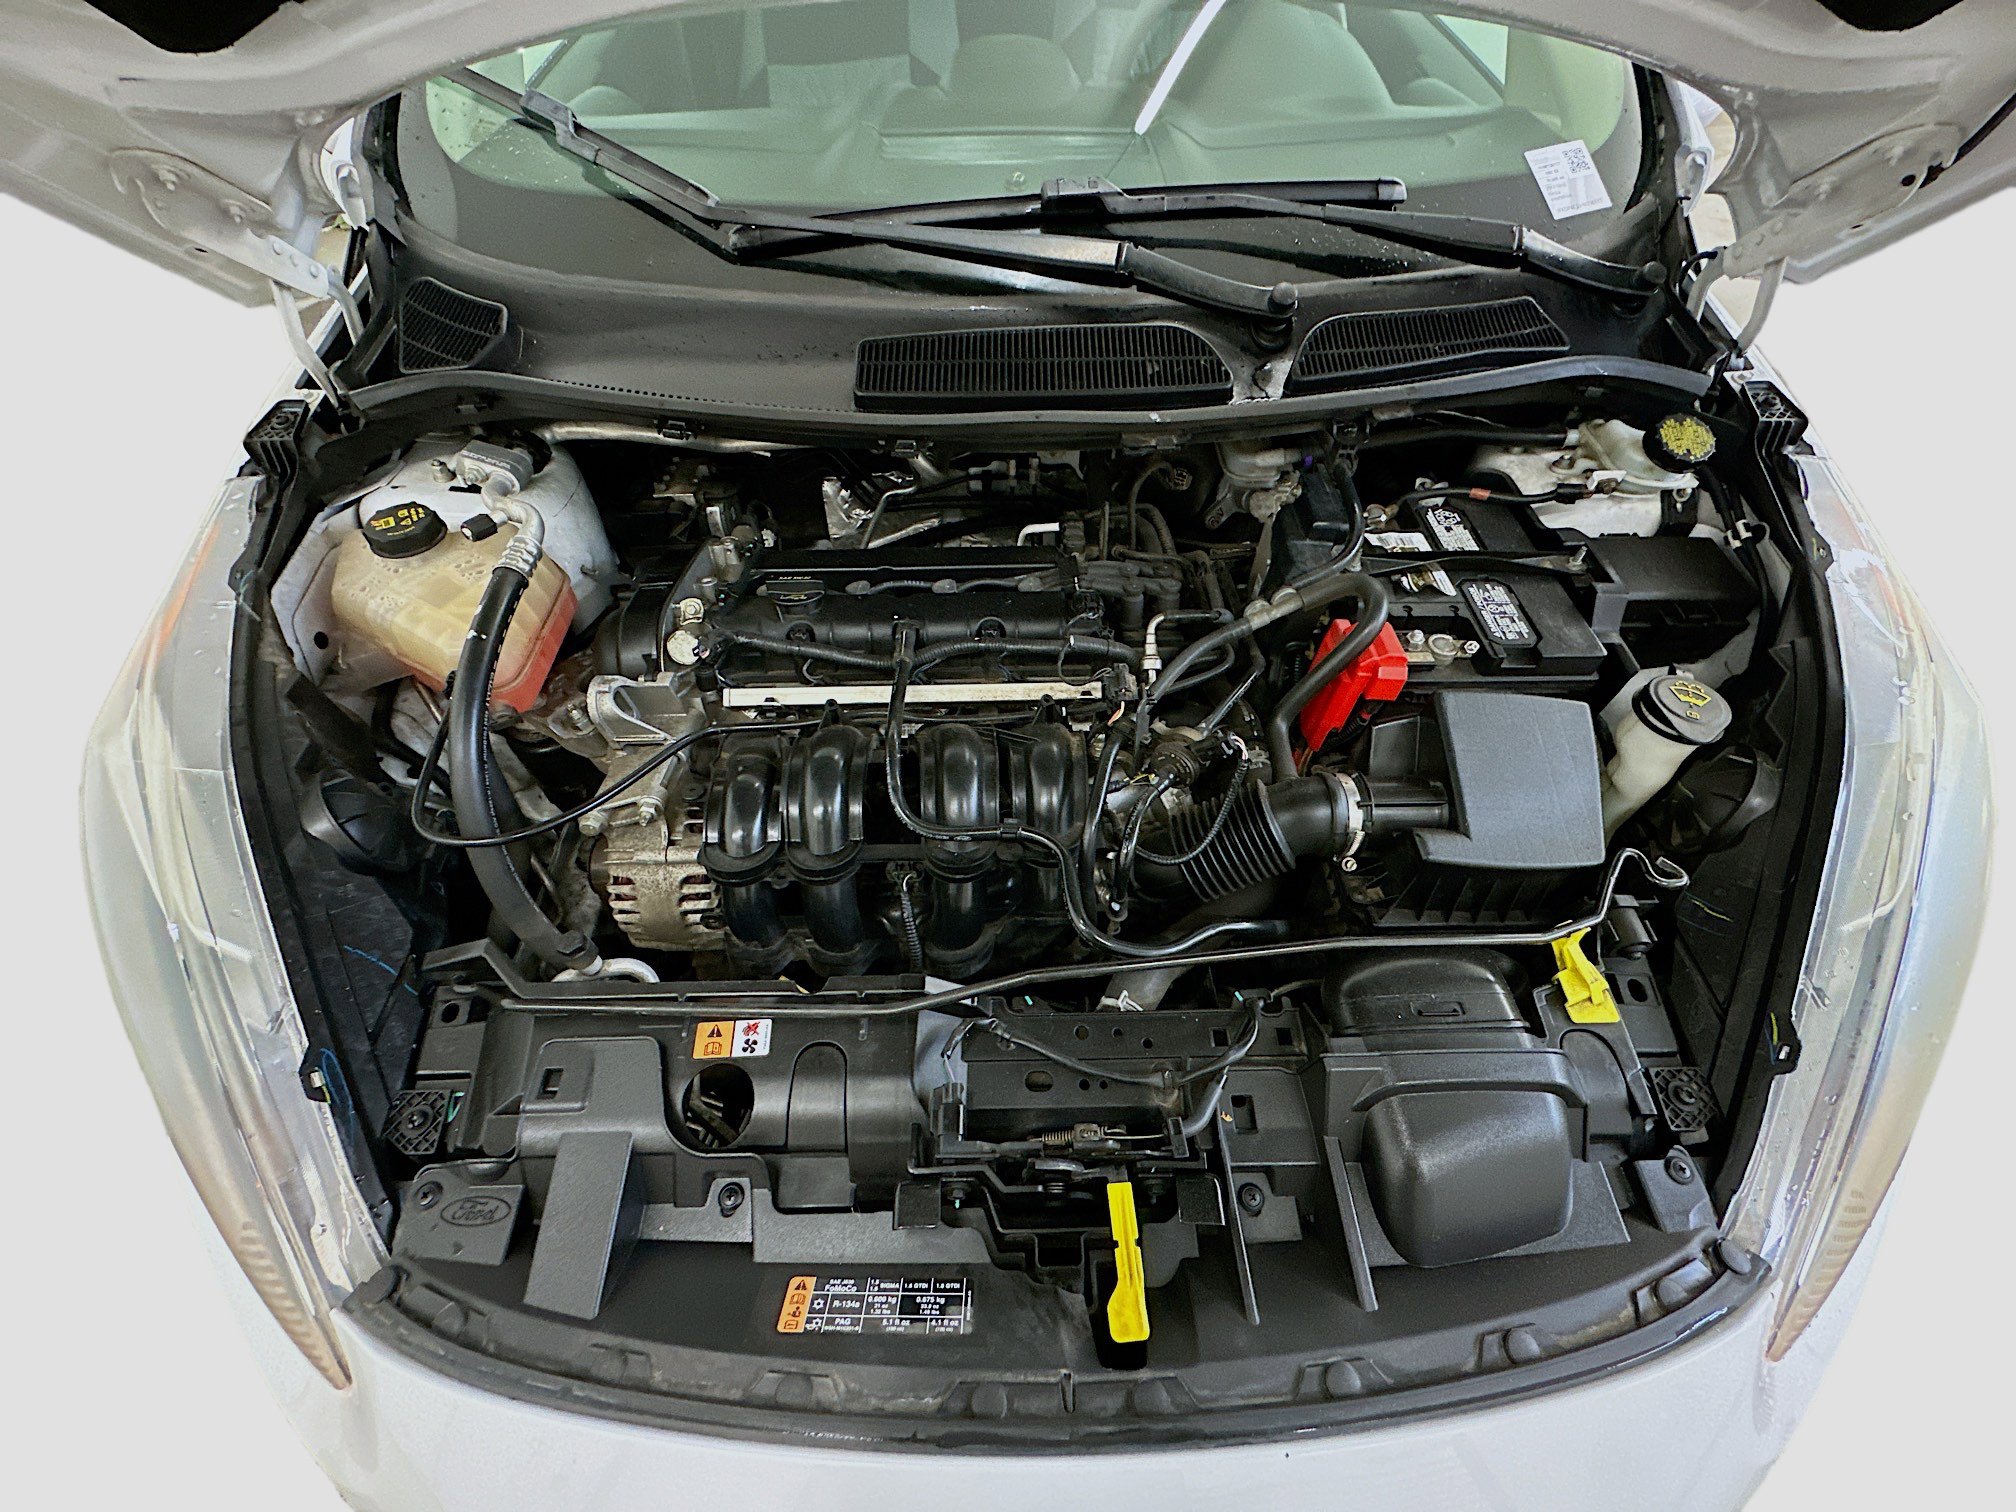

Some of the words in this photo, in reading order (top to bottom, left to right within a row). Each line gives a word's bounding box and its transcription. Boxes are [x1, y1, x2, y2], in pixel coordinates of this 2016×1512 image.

[451, 1199, 499, 1221] Ford
[824, 1284, 857, 1292] FoMoCo
[832, 1300, 860, 1308] R-134a
[887, 1296, 898, 1304] kg
[936, 1296, 946, 1305] kg
